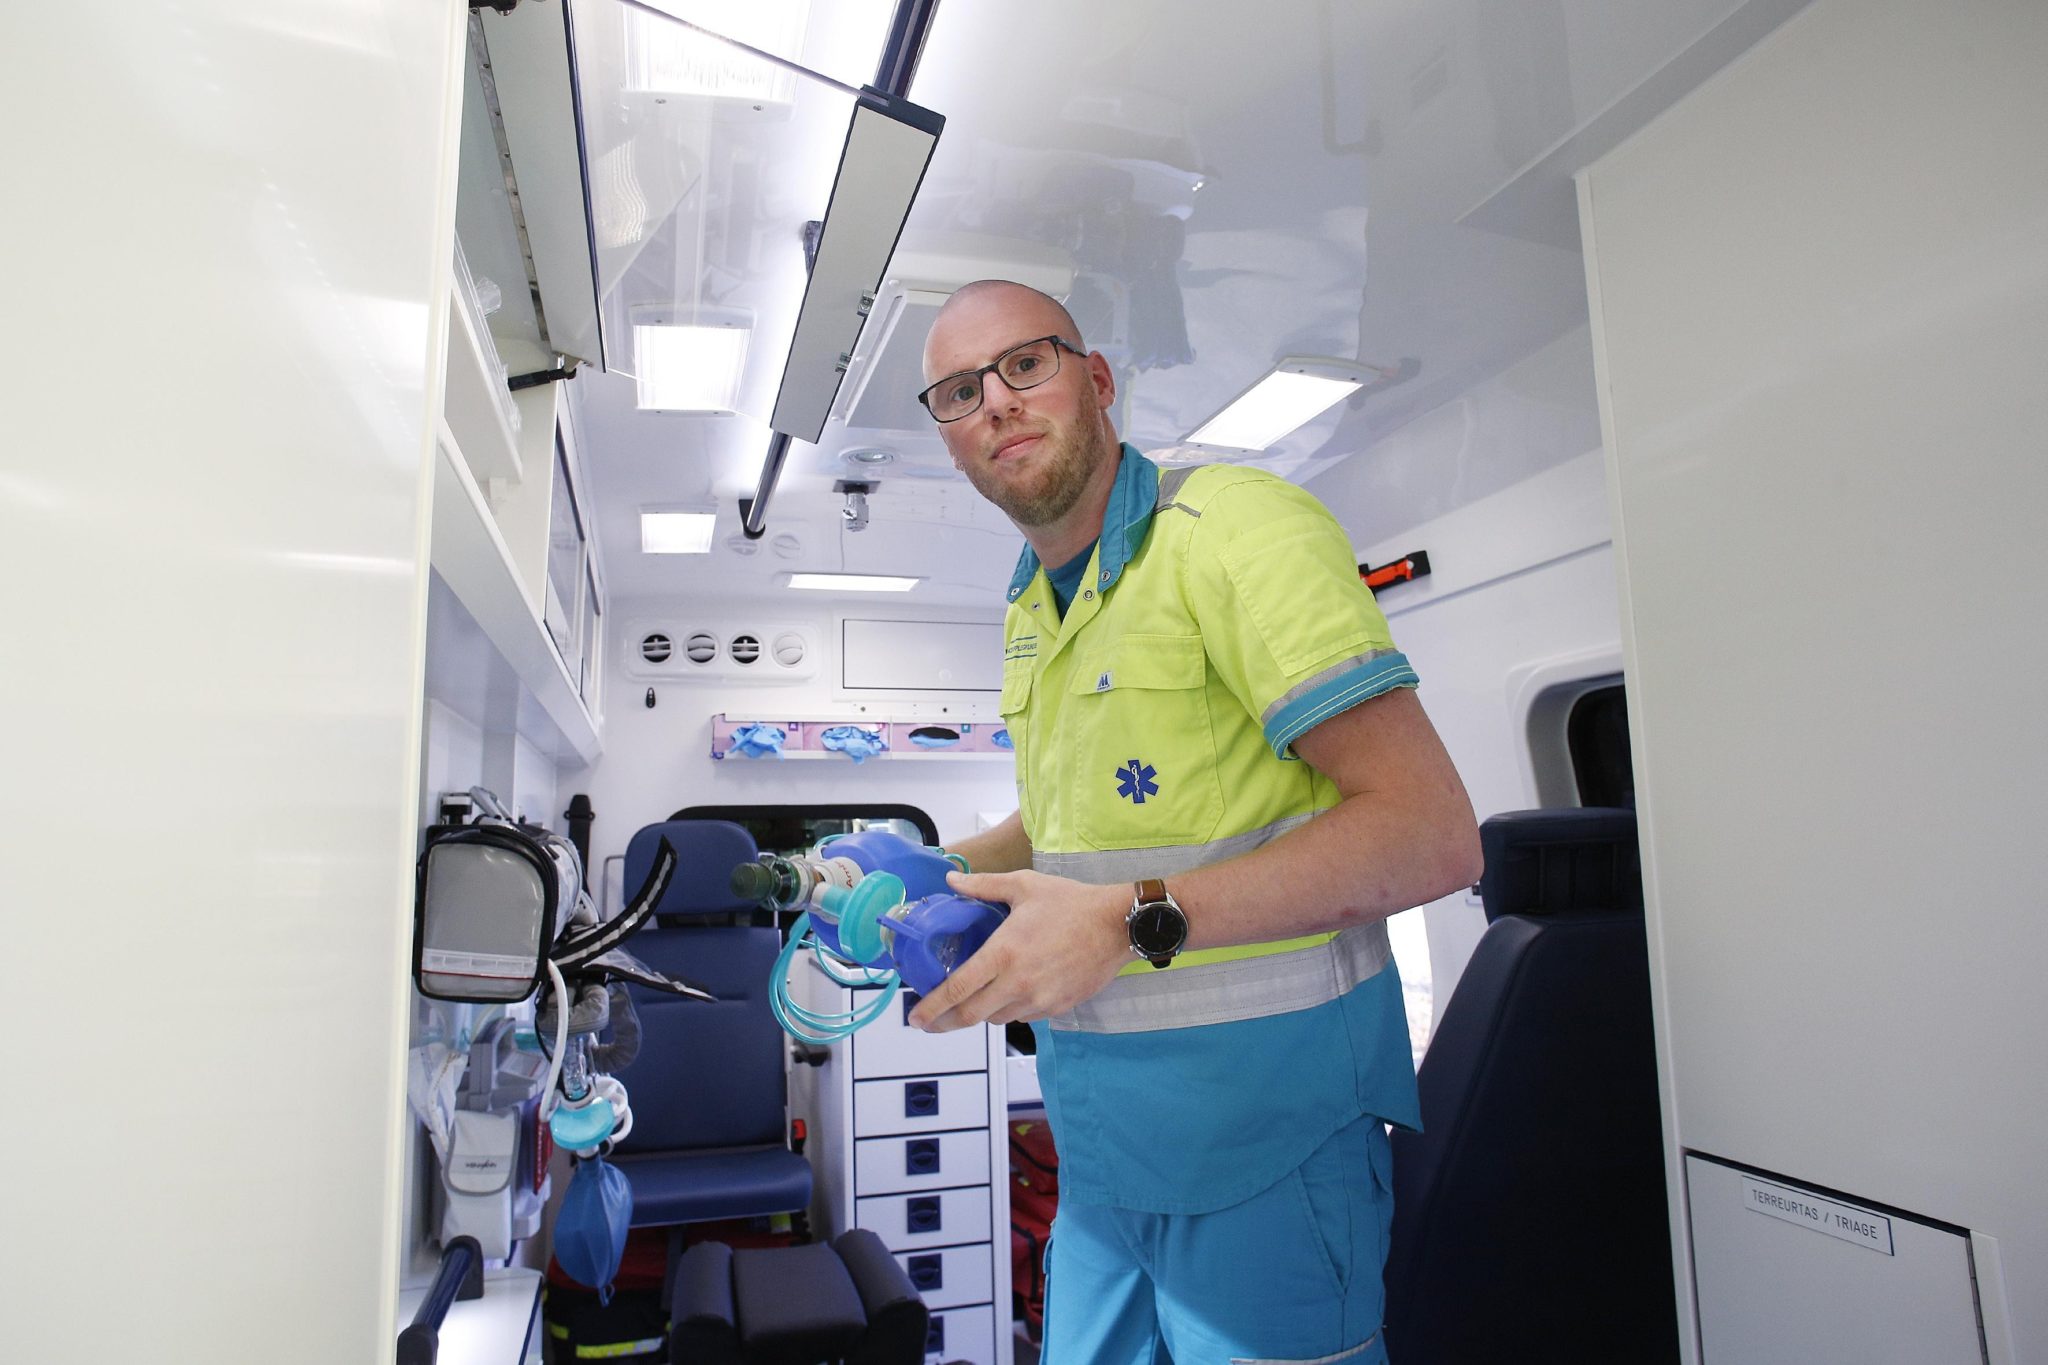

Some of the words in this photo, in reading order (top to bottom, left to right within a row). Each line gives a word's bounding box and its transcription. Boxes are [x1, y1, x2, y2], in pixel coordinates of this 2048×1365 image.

[1752, 1189, 1819, 1221] TERREURTAS
[1824, 1213, 1829, 1223] /
[1835, 1214, 1878, 1239] TRIAGE
